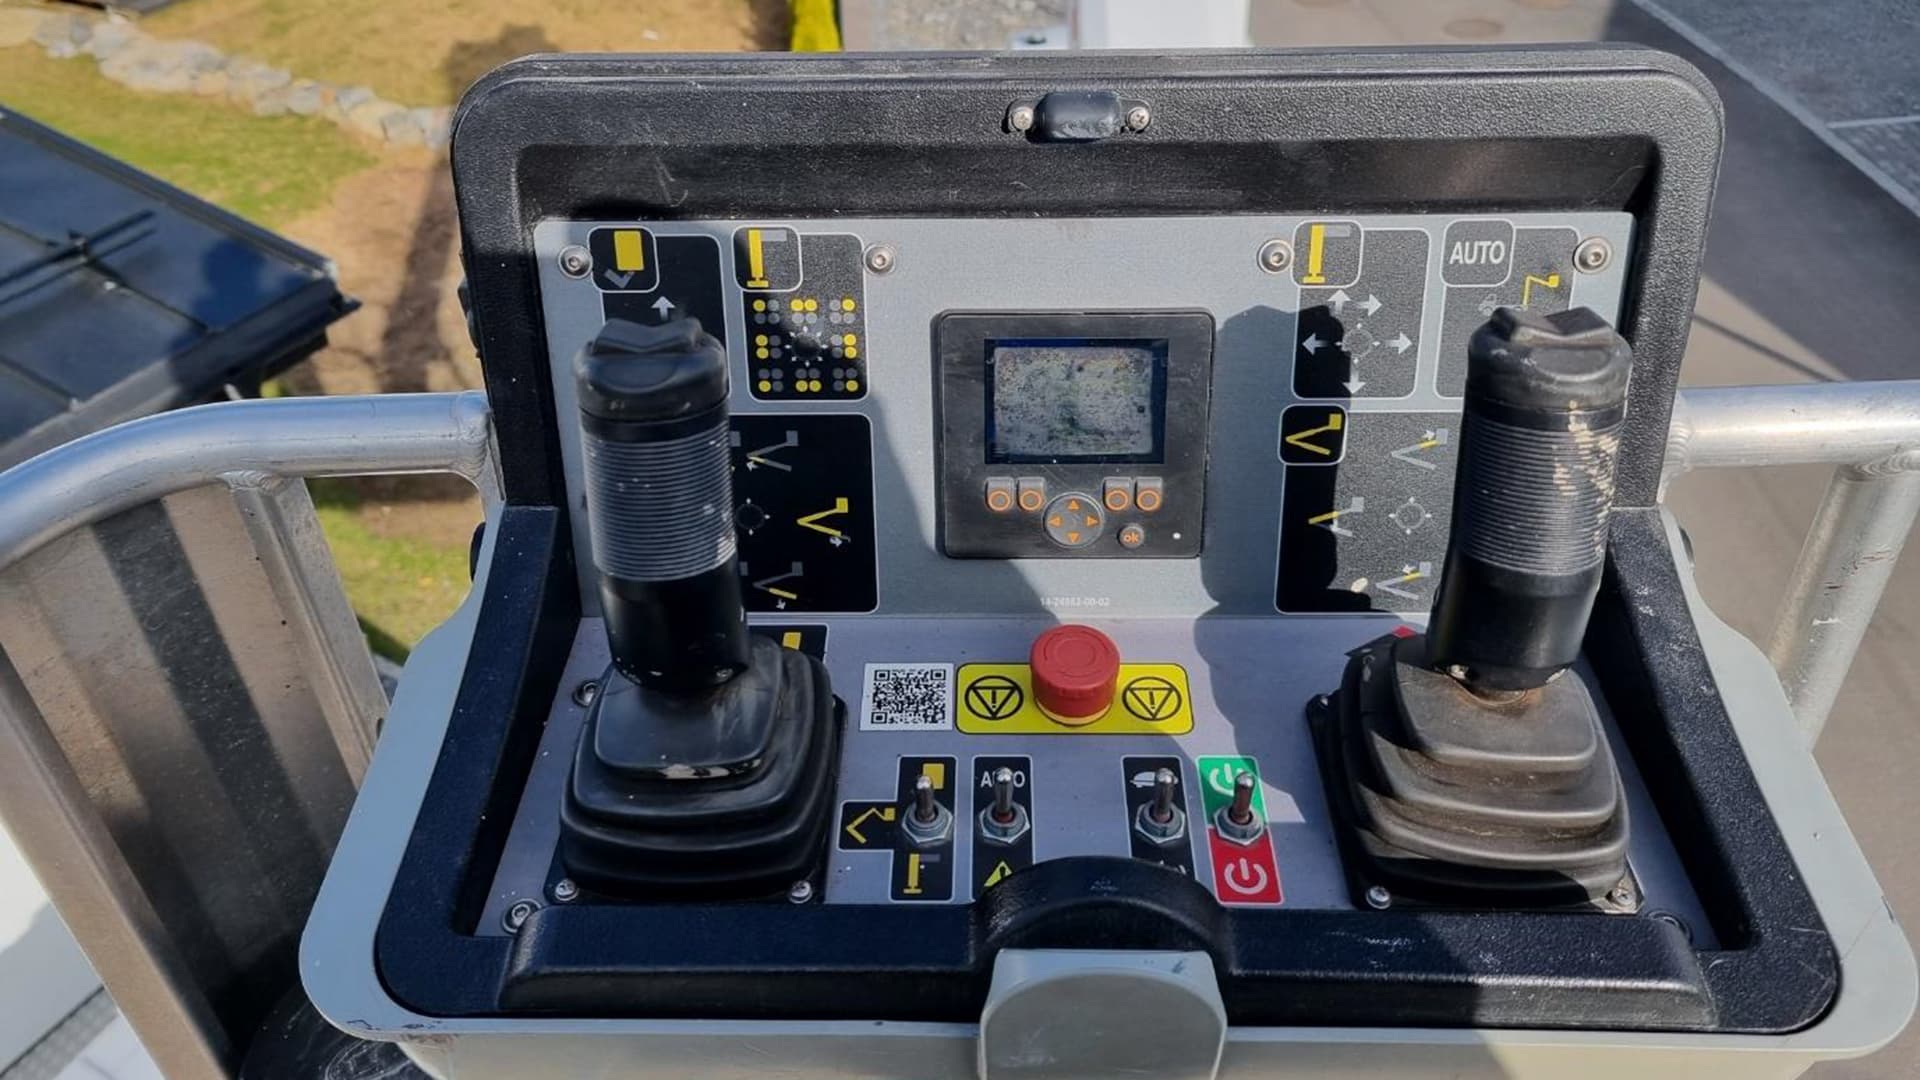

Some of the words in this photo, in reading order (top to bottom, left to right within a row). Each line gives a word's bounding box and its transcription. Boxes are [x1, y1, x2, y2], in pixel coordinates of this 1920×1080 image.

[1449, 240, 1505, 265] AUTO
[1123, 531, 1139, 544] ok
[980, 770, 1026, 788] AO
